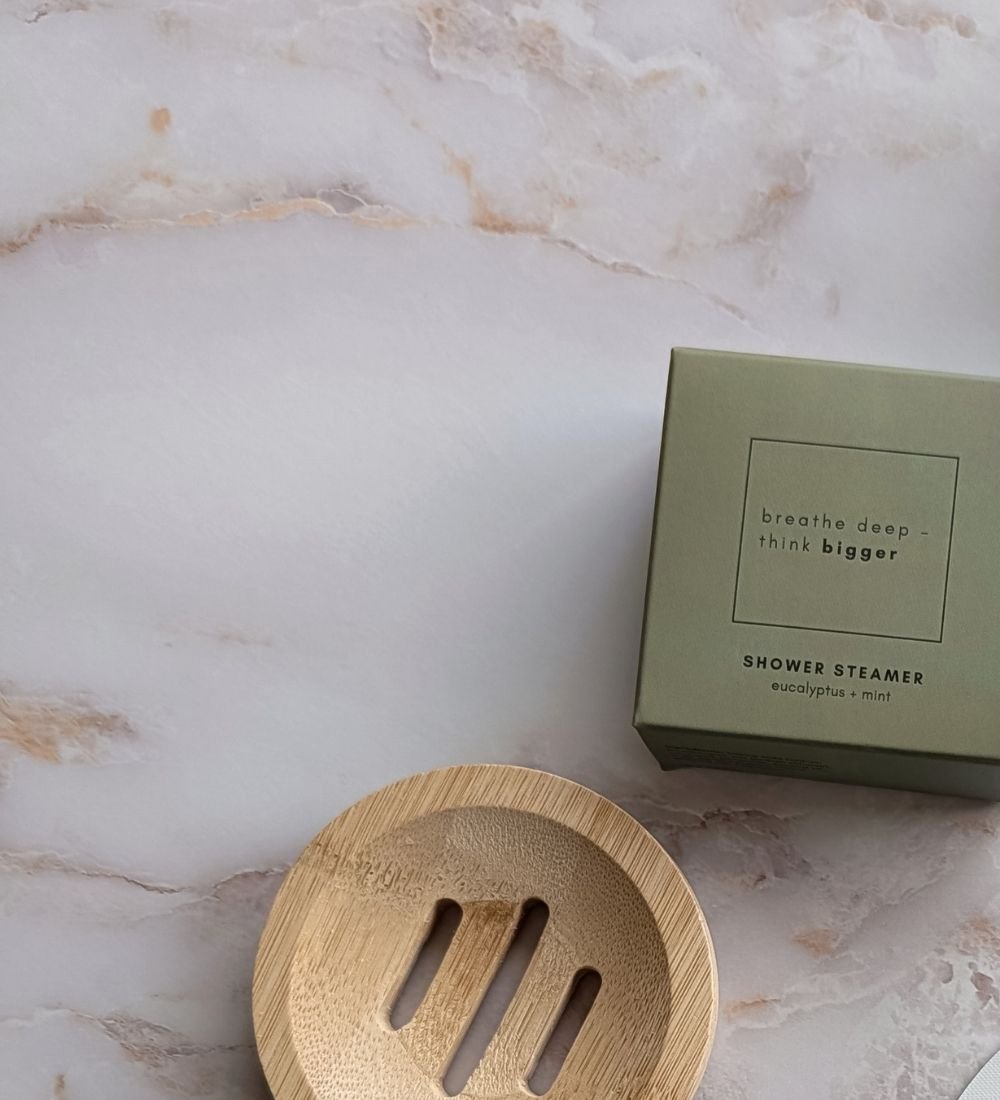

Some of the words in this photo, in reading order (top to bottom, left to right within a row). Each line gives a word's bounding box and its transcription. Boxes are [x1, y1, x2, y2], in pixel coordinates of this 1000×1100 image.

[761, 507, 846, 530] breathe
[857, 516, 909, 541] deep
[759, 532, 811, 553] think
[822, 537, 898, 562] bigger
[742, 654, 825, 675] SHOWER
[833, 663, 924, 686] STEAMER
[771, 680, 846, 700] eucalyptus
[850, 690, 857, 698] +
[861, 689, 892, 702] mint
